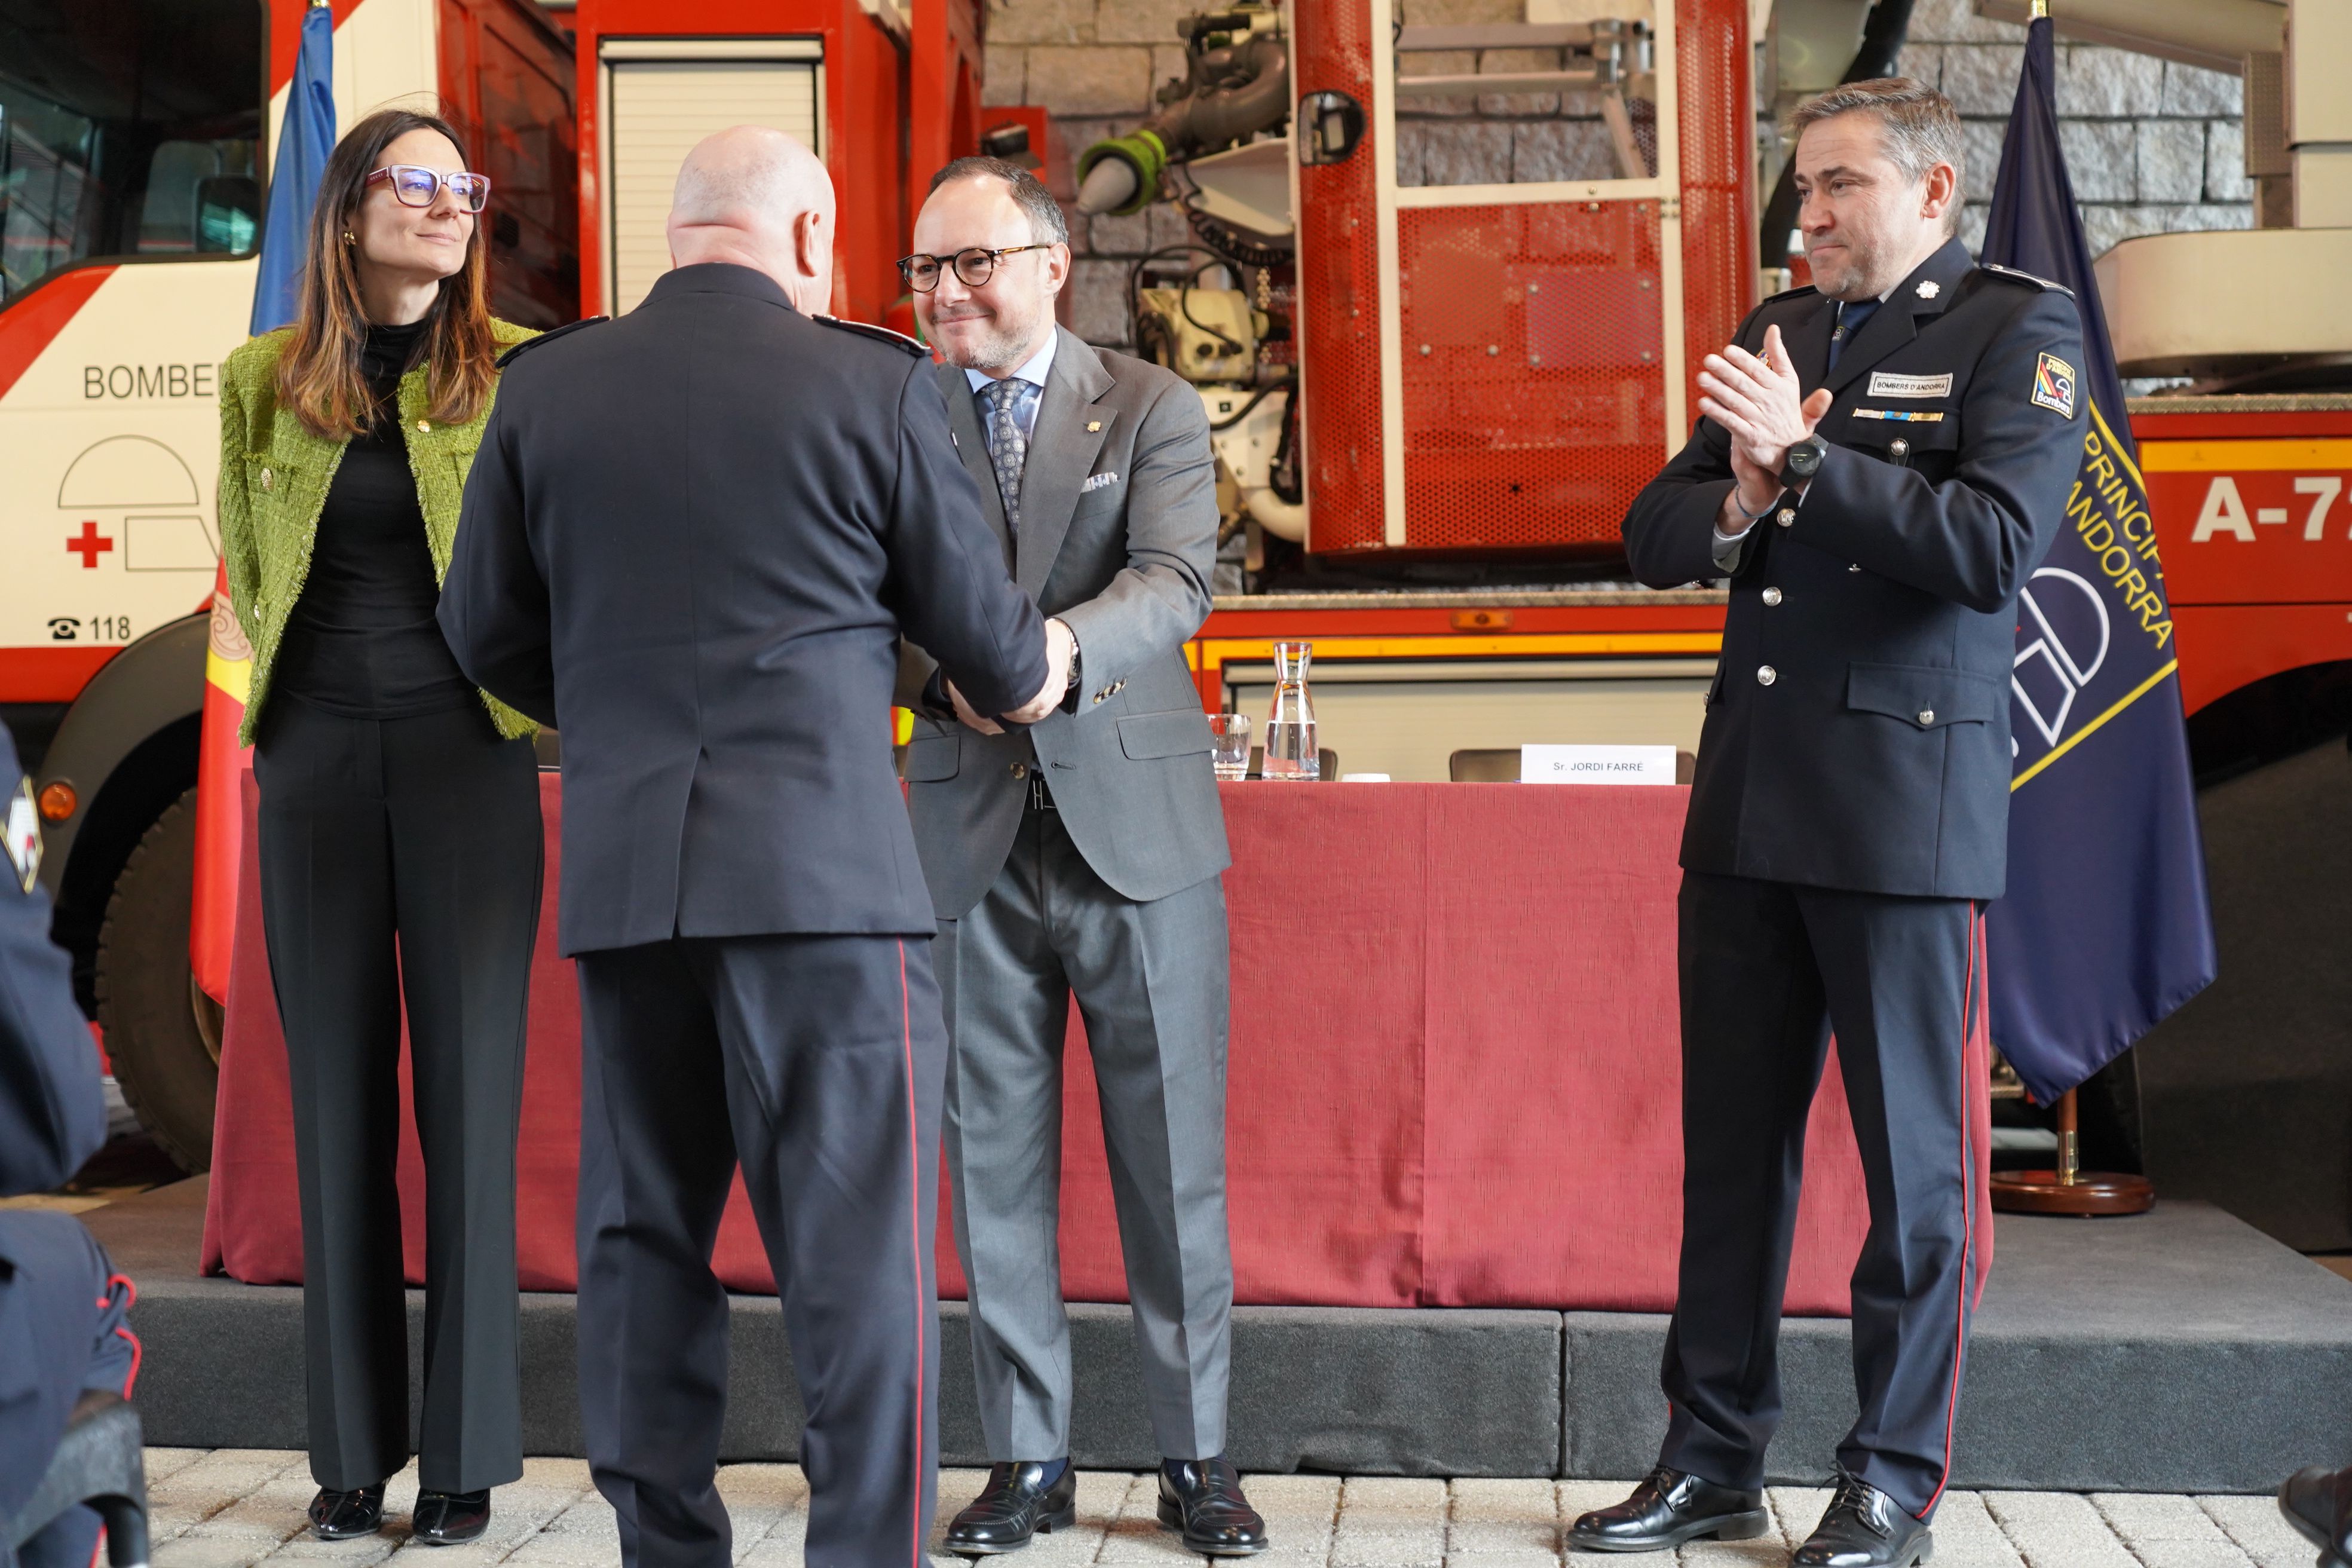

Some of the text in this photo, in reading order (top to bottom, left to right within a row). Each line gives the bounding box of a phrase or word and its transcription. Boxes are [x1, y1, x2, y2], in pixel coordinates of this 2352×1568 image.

[84, 363, 223, 399] BOMBE
[1877, 382, 1909, 390] BOMBERS
[2036, 391, 2071, 414] Bombers
[2191, 476, 2352, 543] A-7
[90, 616, 130, 640] 118
[1554, 761, 1644, 771] Sr. JORDI FARRÉ
